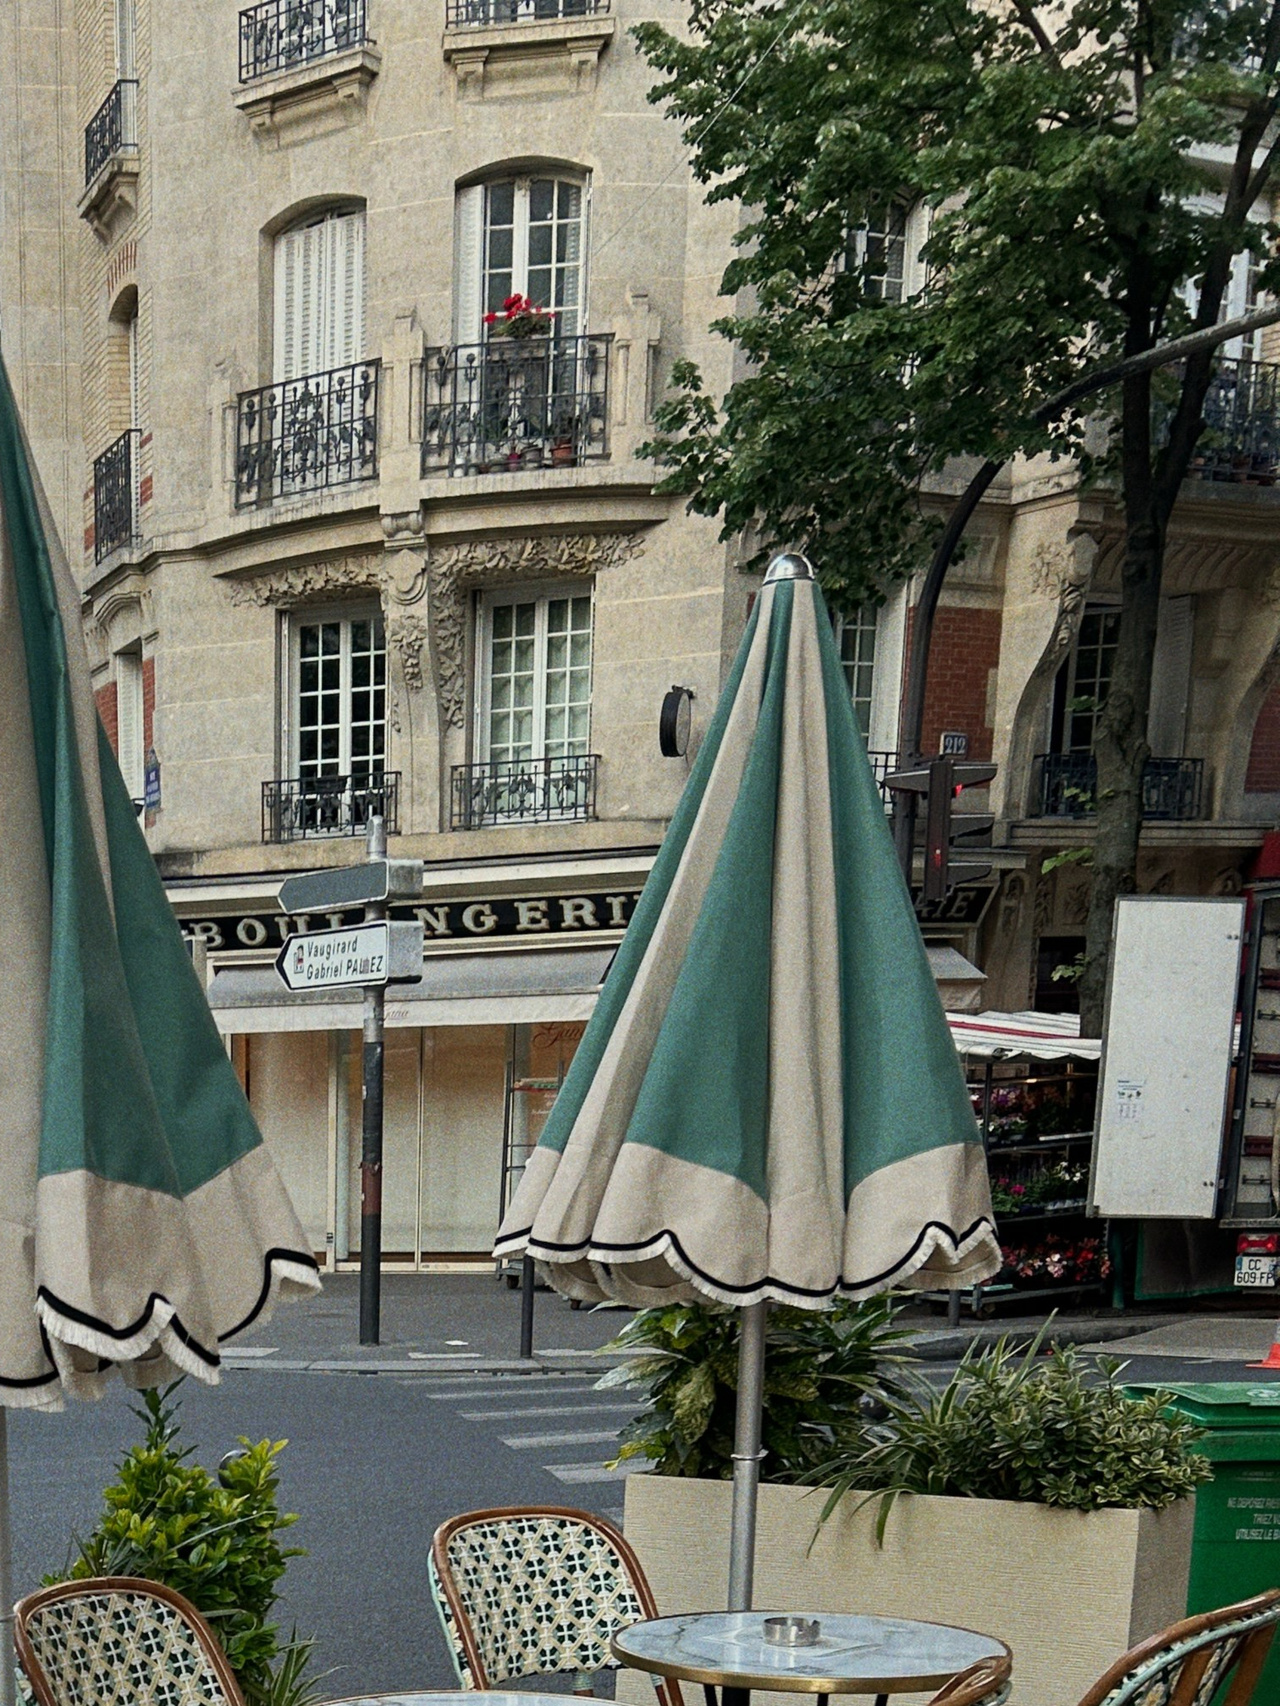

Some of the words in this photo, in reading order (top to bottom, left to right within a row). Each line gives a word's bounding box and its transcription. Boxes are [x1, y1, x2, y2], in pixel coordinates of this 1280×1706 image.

[945, 736, 966, 754] 212
[189, 895, 641, 948] BOUNGERI
[307, 936, 358, 961] Vaugirard
[307, 960, 342, 981] Gabriel
[345, 954, 383, 977] PALEZ
[1248, 1258, 1262, 1271] CC
